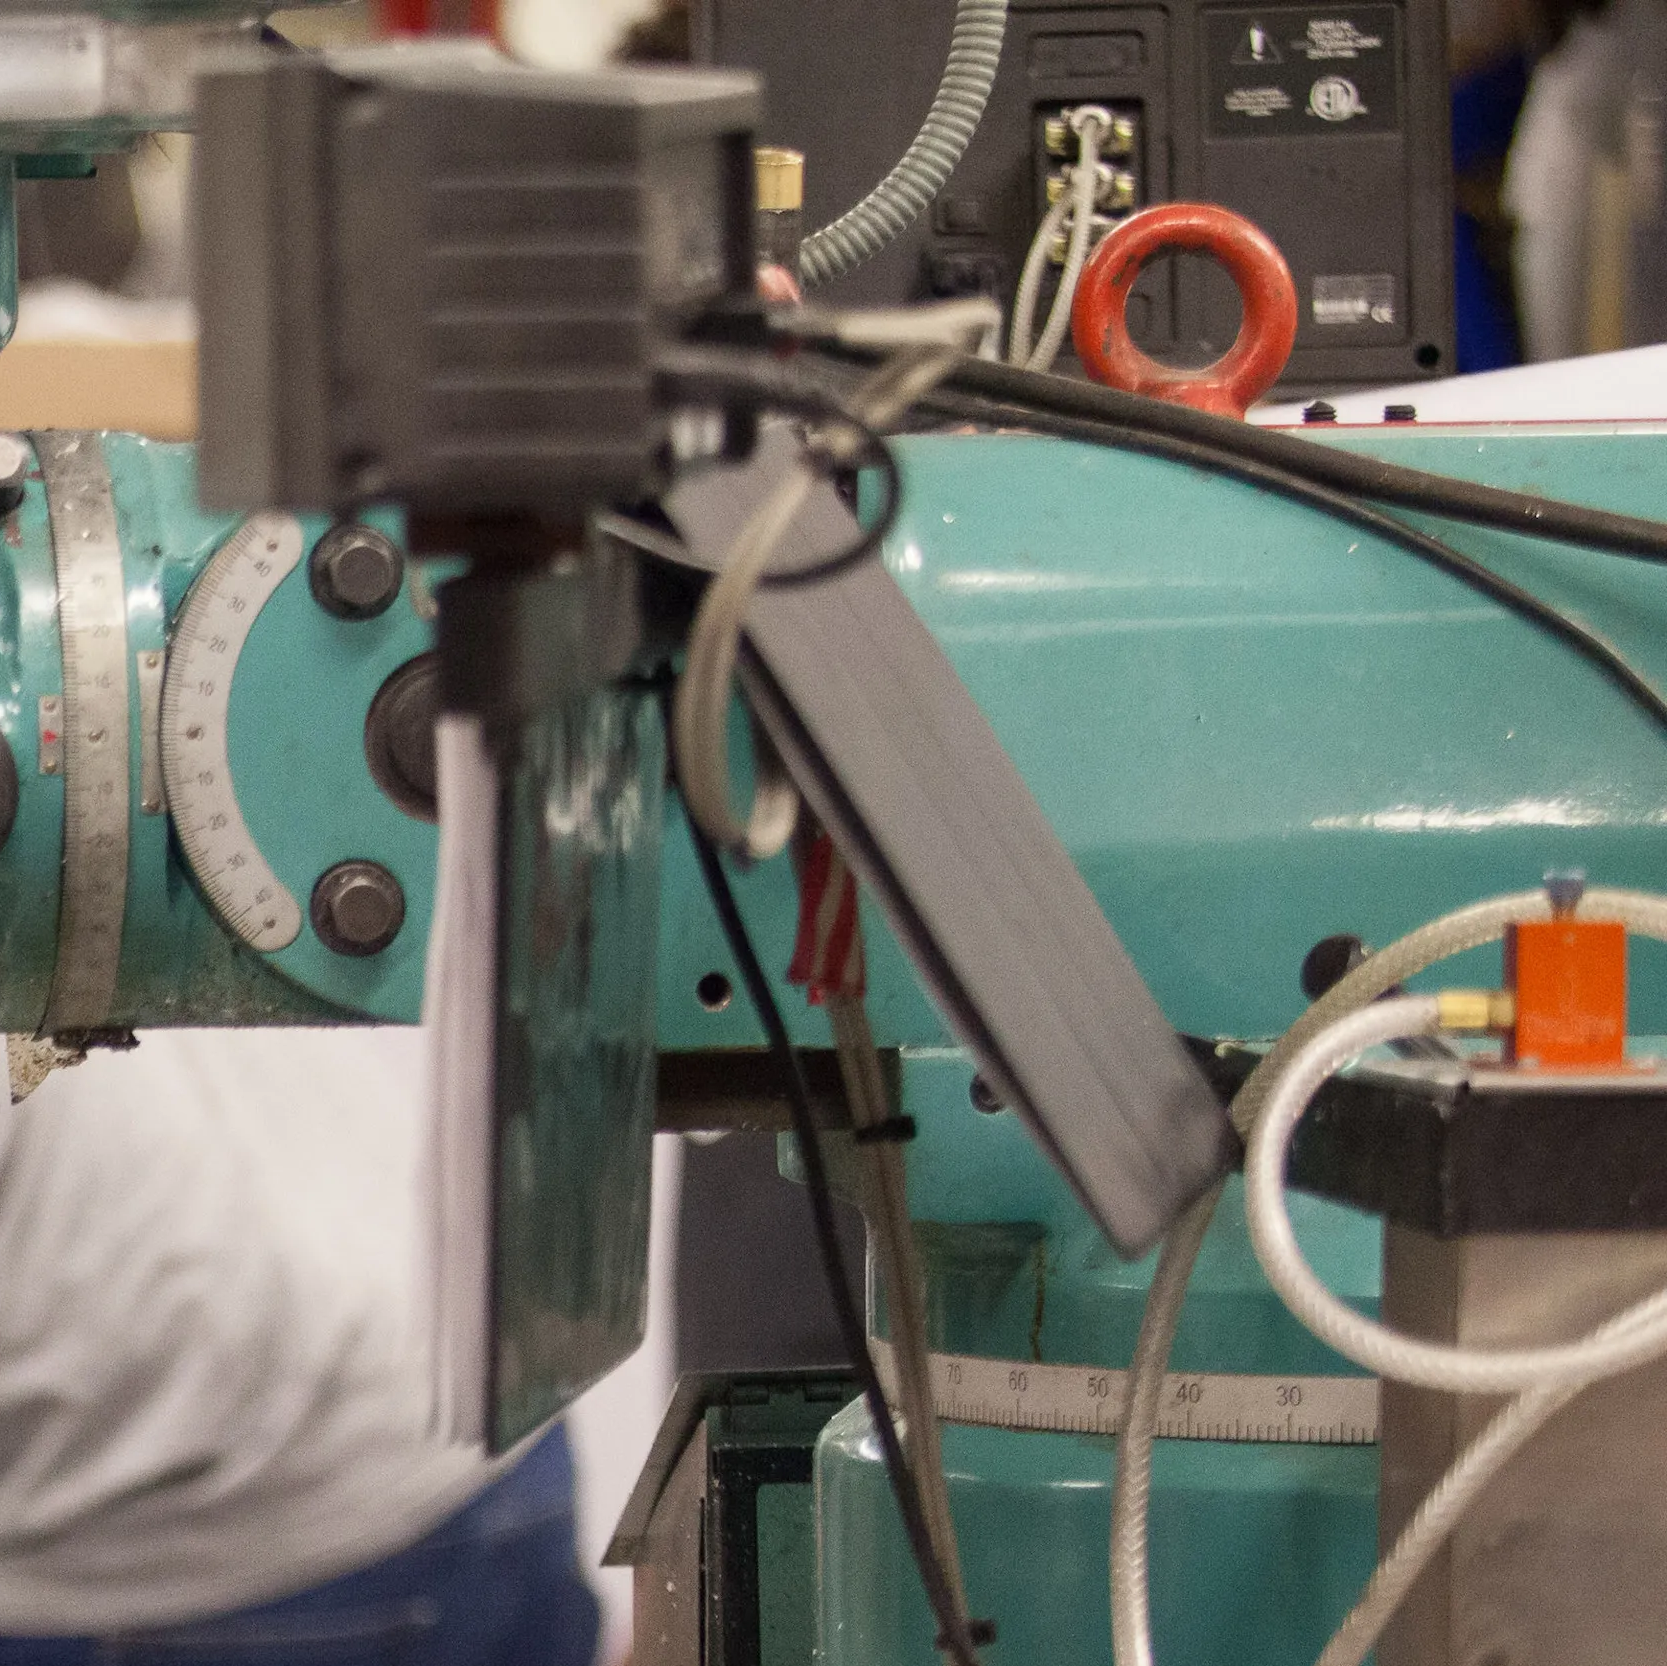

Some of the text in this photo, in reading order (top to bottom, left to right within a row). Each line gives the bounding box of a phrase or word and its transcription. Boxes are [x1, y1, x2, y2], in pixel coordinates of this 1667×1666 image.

[209, 635, 227, 654] 20
[199, 680, 214, 697] 10
[946, 1363, 1302, 1407] 70 60 50 40 30
